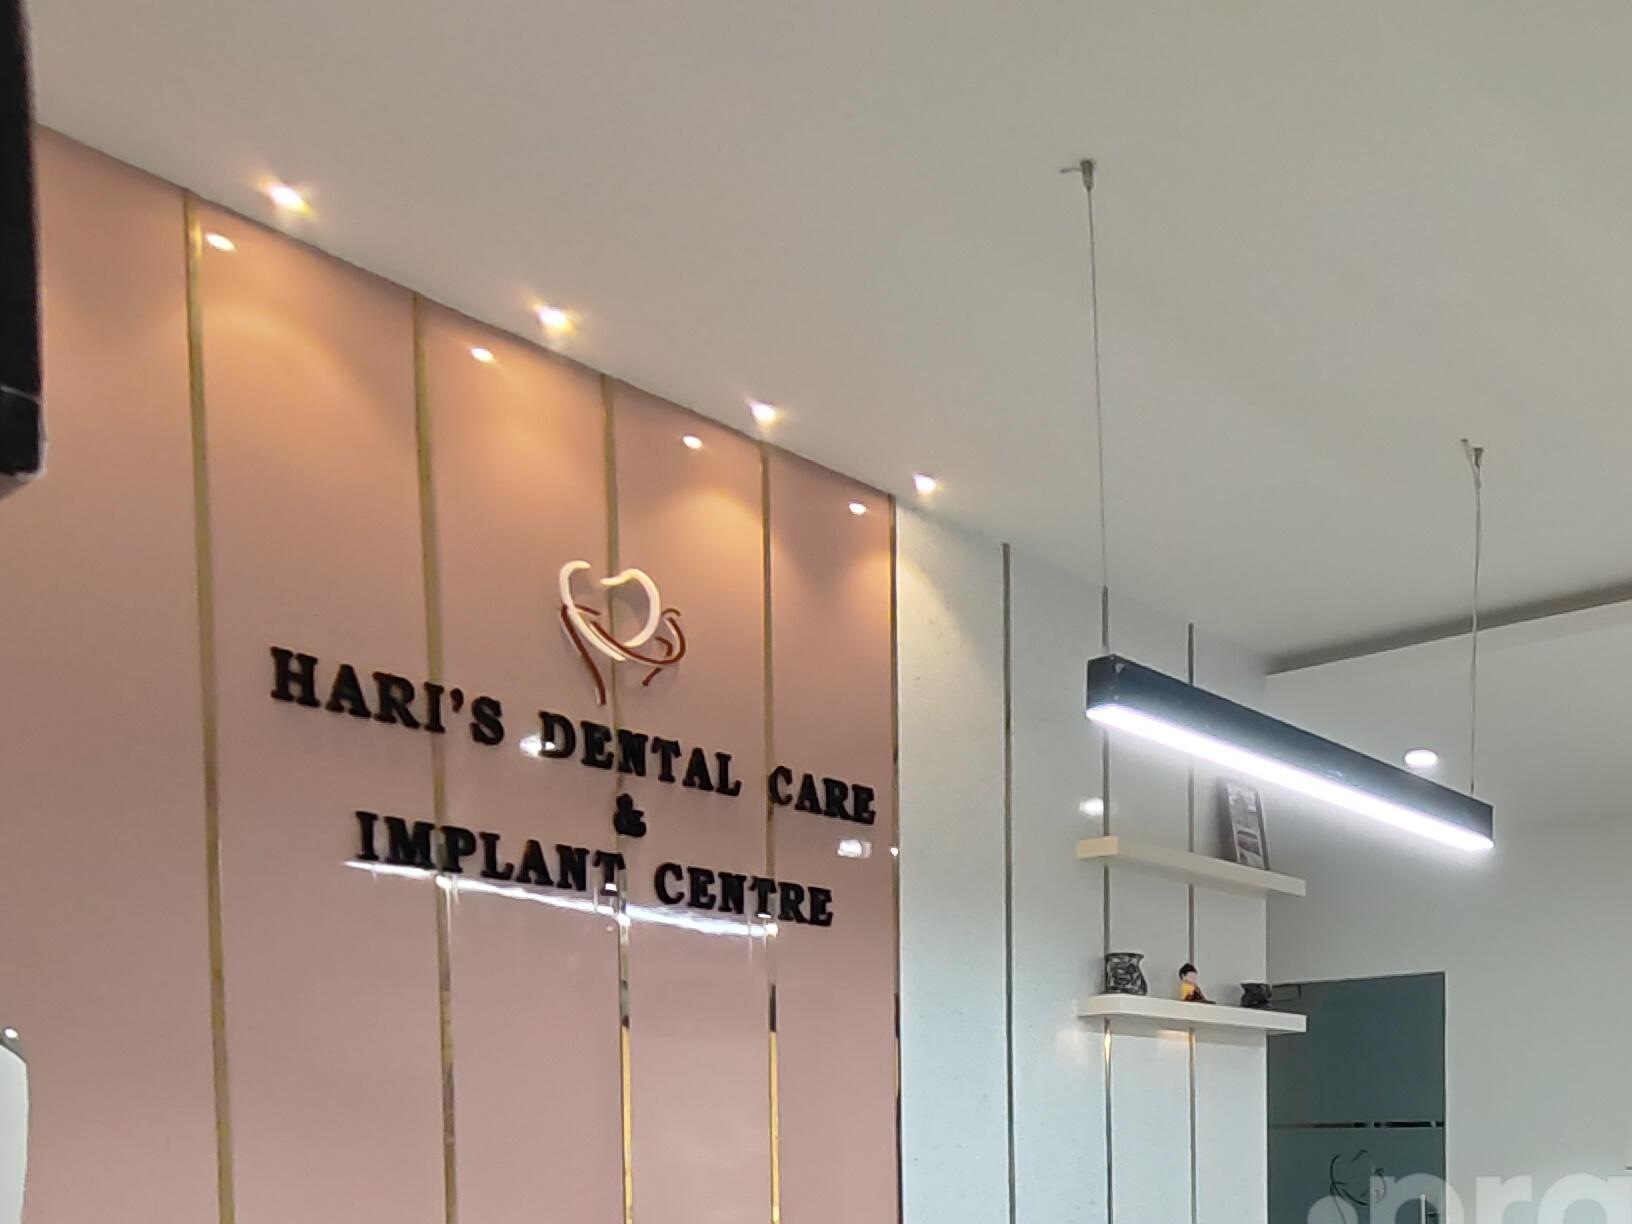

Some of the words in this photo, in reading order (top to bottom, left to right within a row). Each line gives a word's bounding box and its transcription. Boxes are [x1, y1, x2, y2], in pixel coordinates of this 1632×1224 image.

[270, 646, 504, 746] HARI'S
[538, 710, 742, 797] DENTAL
[768, 765, 876, 825] CARE
[355, 810, 626, 896] IMPLANT
[654, 862, 834, 927] CENTRE
[613, 793, 647, 838] &
